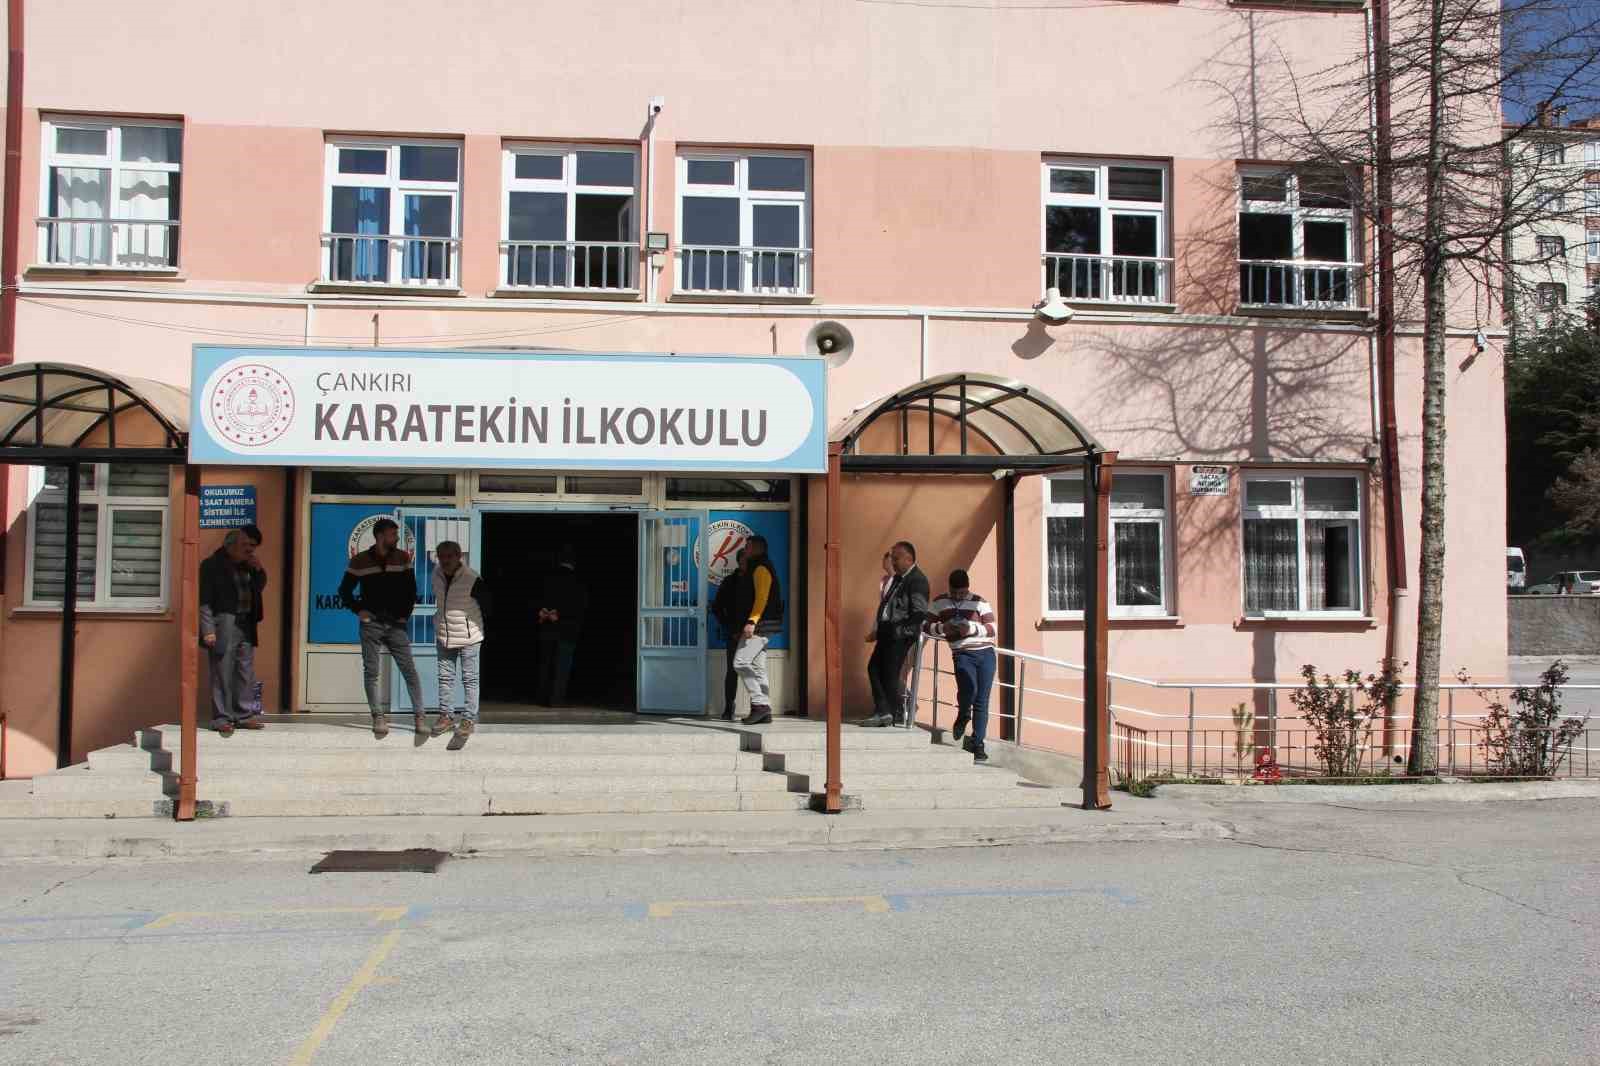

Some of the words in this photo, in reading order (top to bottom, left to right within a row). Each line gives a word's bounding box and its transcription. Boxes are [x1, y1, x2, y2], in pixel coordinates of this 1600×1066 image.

[316, 372, 412, 396] ÇANKIRI
[314, 396, 549, 443] KARATEKİN
[562, 397, 768, 447] İLKOKULU
